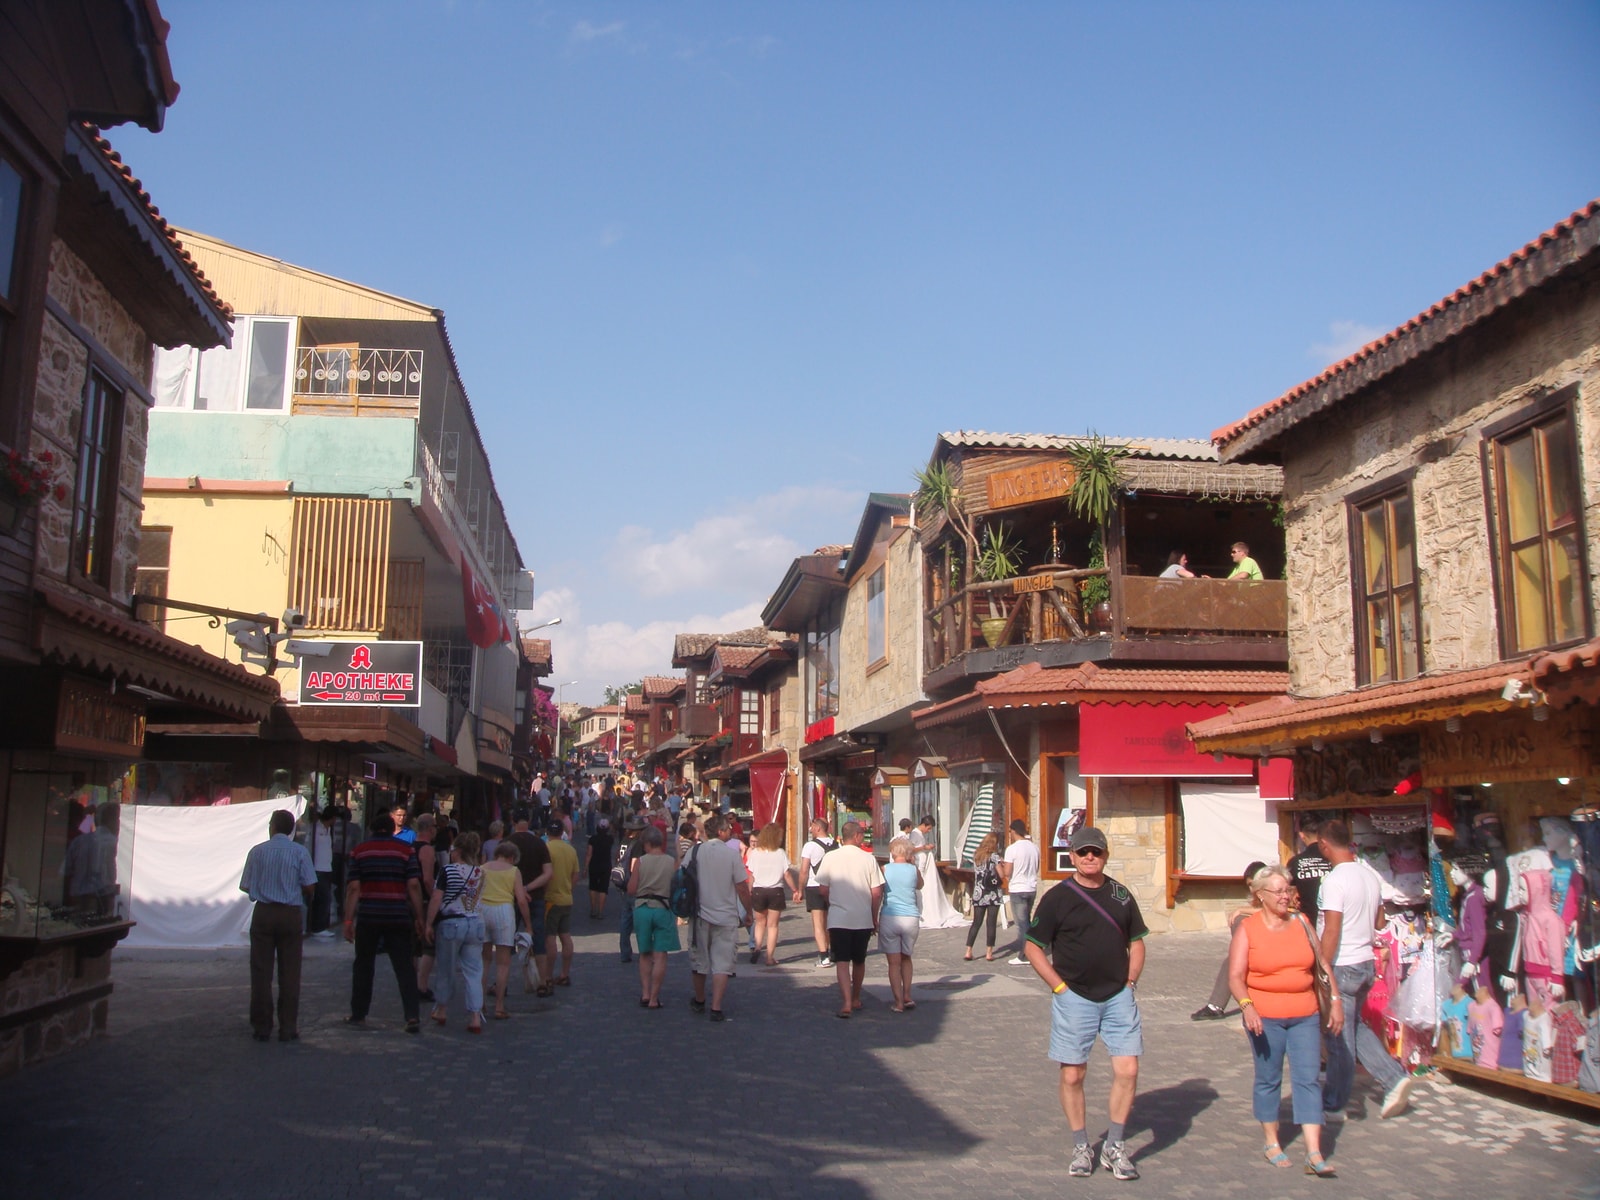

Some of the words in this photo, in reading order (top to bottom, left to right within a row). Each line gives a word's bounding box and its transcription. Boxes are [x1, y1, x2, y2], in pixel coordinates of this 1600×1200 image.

[1041, 463, 1070, 493] BAR
[1014, 575, 1052, 593] JUNGLE
[306, 671, 414, 691] APOTHEKE
[345, 691, 361, 701] 20
[364, 692, 381, 701] mt
